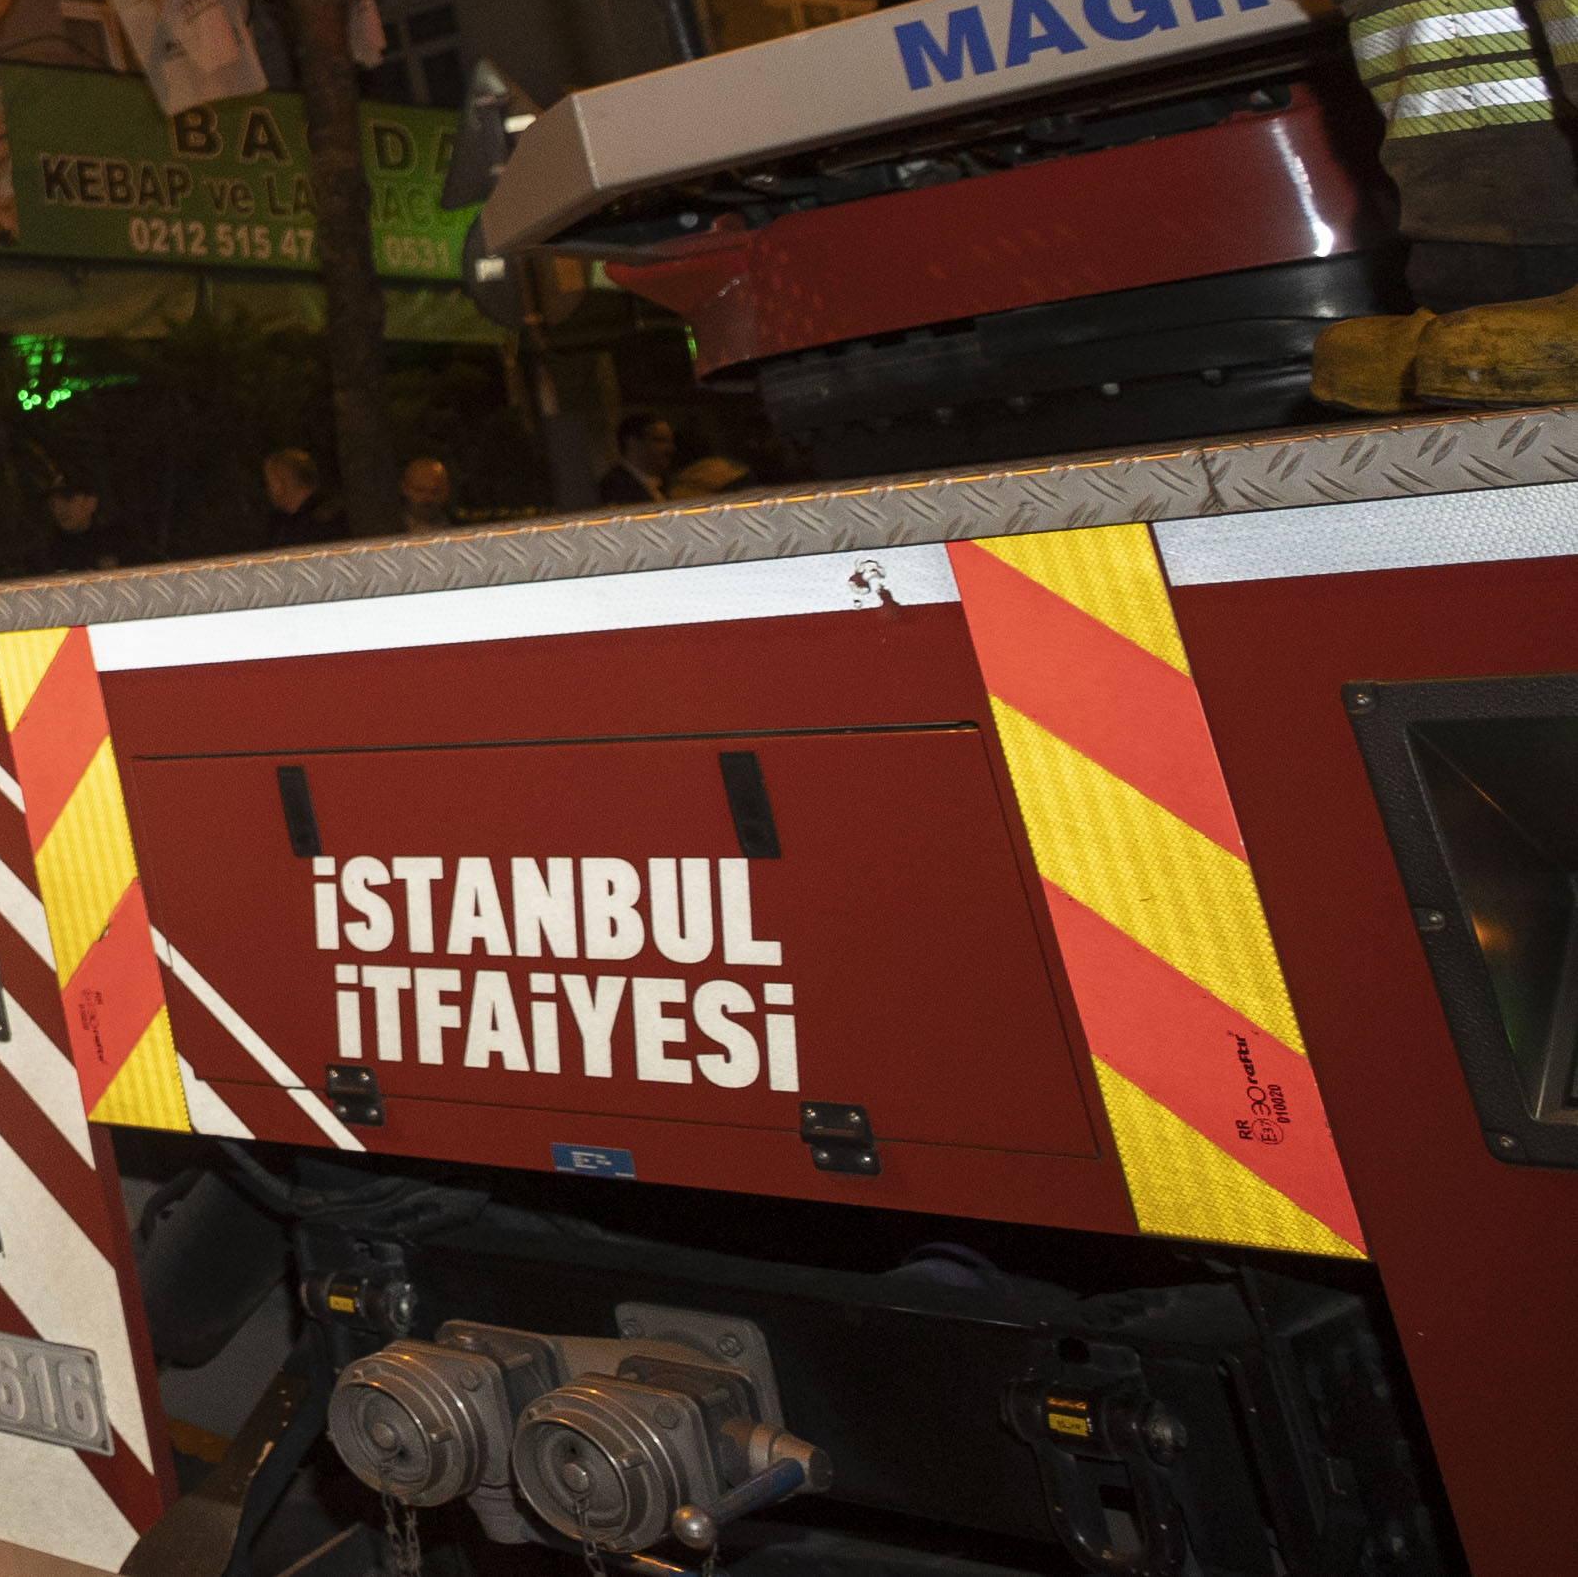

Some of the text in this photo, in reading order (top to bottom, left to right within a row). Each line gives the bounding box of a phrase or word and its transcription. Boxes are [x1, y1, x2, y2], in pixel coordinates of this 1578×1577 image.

[42, 153, 192, 211] KEBAP
[128, 217, 208, 256] 0212
[215, 223, 272, 260] 515
